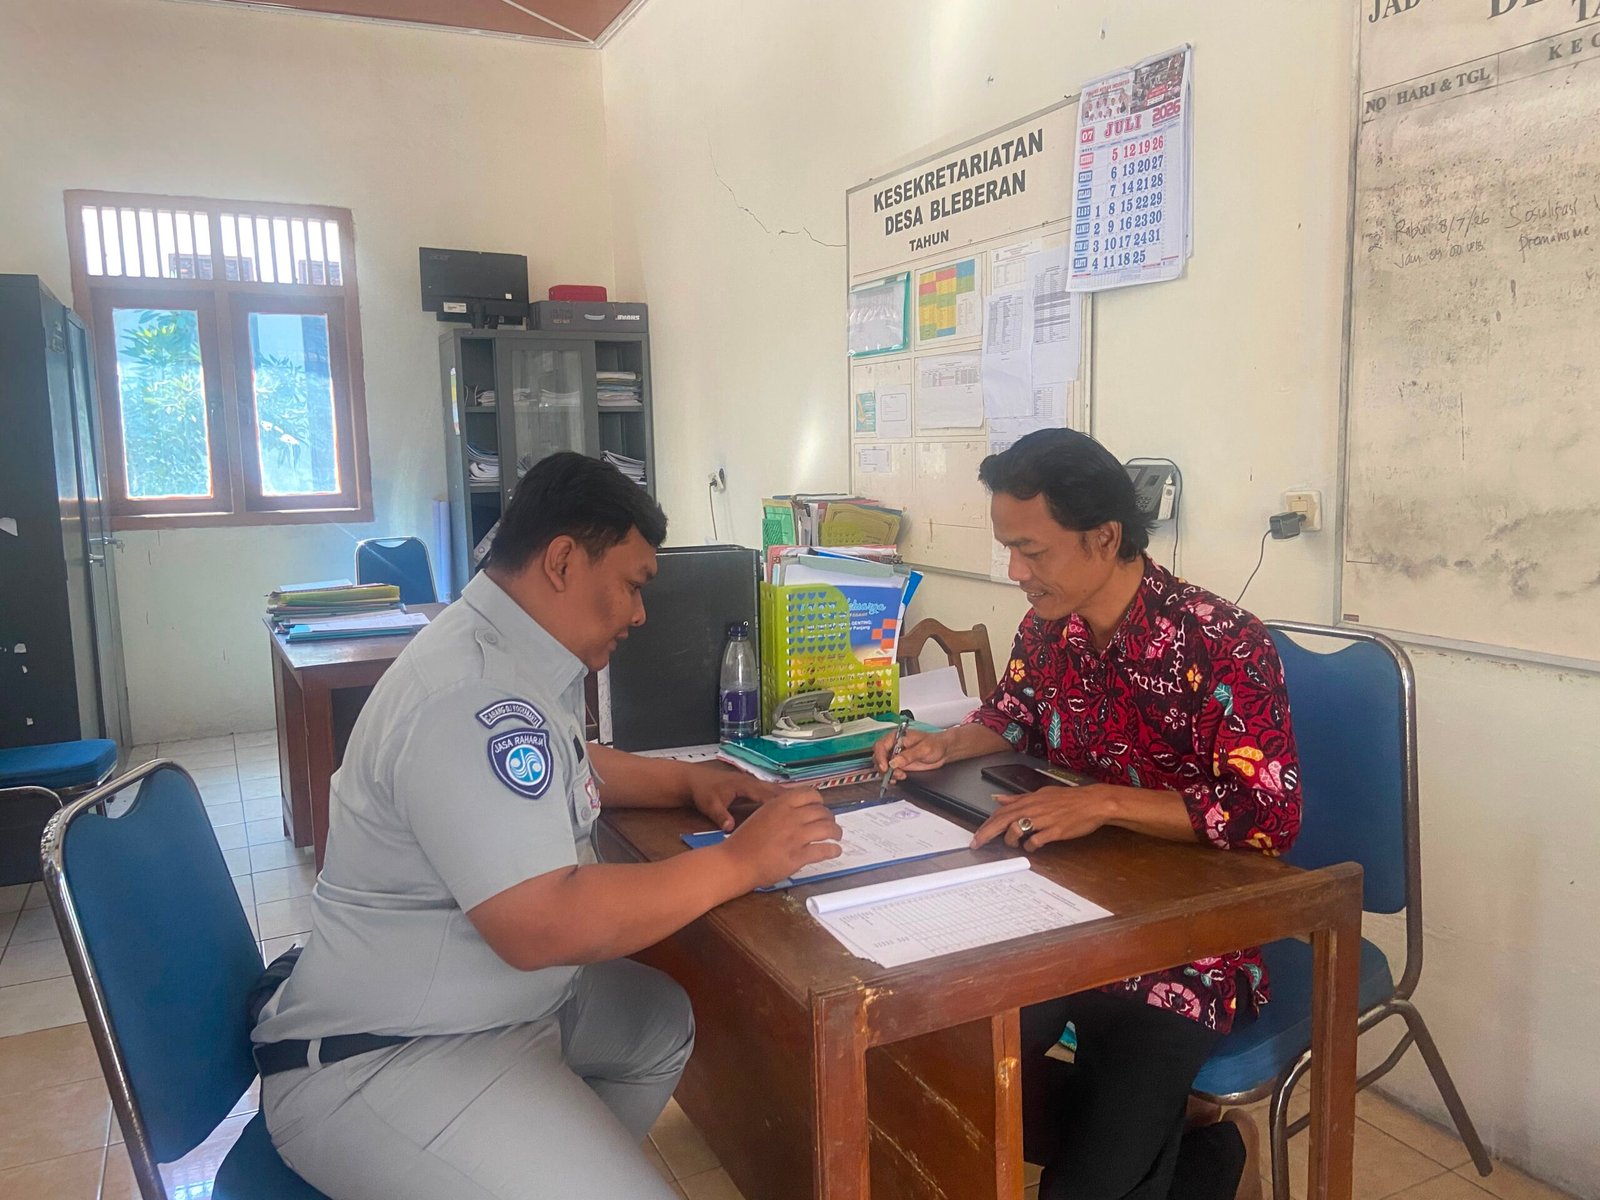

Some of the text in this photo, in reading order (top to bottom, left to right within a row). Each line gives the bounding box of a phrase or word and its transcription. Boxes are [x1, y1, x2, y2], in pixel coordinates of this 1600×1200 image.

[1365, 67, 1490, 114] NO HARI & TGL
[1082, 131, 1093, 141] 07
[1104, 114, 1142, 138] JULI
[1152, 100, 1180, 122] 2026
[1112, 135, 1164, 161] 5 12 19 26
[873, 128, 1043, 213] KESEKRETARIATAN
[1111, 155, 1163, 179] 6 13 20 27
[1110, 173, 1163, 197] 7 14 21 28
[885, 169, 1026, 236] DESA BLEBERAN
[1096, 205, 1100, 218] 1
[1109, 202, 1115, 215] 8
[1121, 198, 1133, 213] 15
[1136, 195, 1149, 209] 22
[1150, 191, 1163, 206] 29
[1093, 222, 1100, 235] 2
[1108, 220, 1114, 233] 9
[1120, 216, 1132, 231] 16
[1134, 213, 1148, 228] 23
[1149, 210, 1162, 225] 30
[909, 229, 949, 252] TAHUN
[1093, 240, 1099, 253] 3
[1104, 237, 1117, 251] 10
[1119, 234, 1132, 248] 17
[1133, 232, 1147, 246] 24
[1148, 228, 1160, 243] 31
[1092, 257, 1098, 269] 4
[1103, 255, 1115, 268] 11
[1117, 252, 1130, 266] 18
[1132, 249, 1146, 264] 25
[495, 735, 544, 753] JASA RAHARJA
